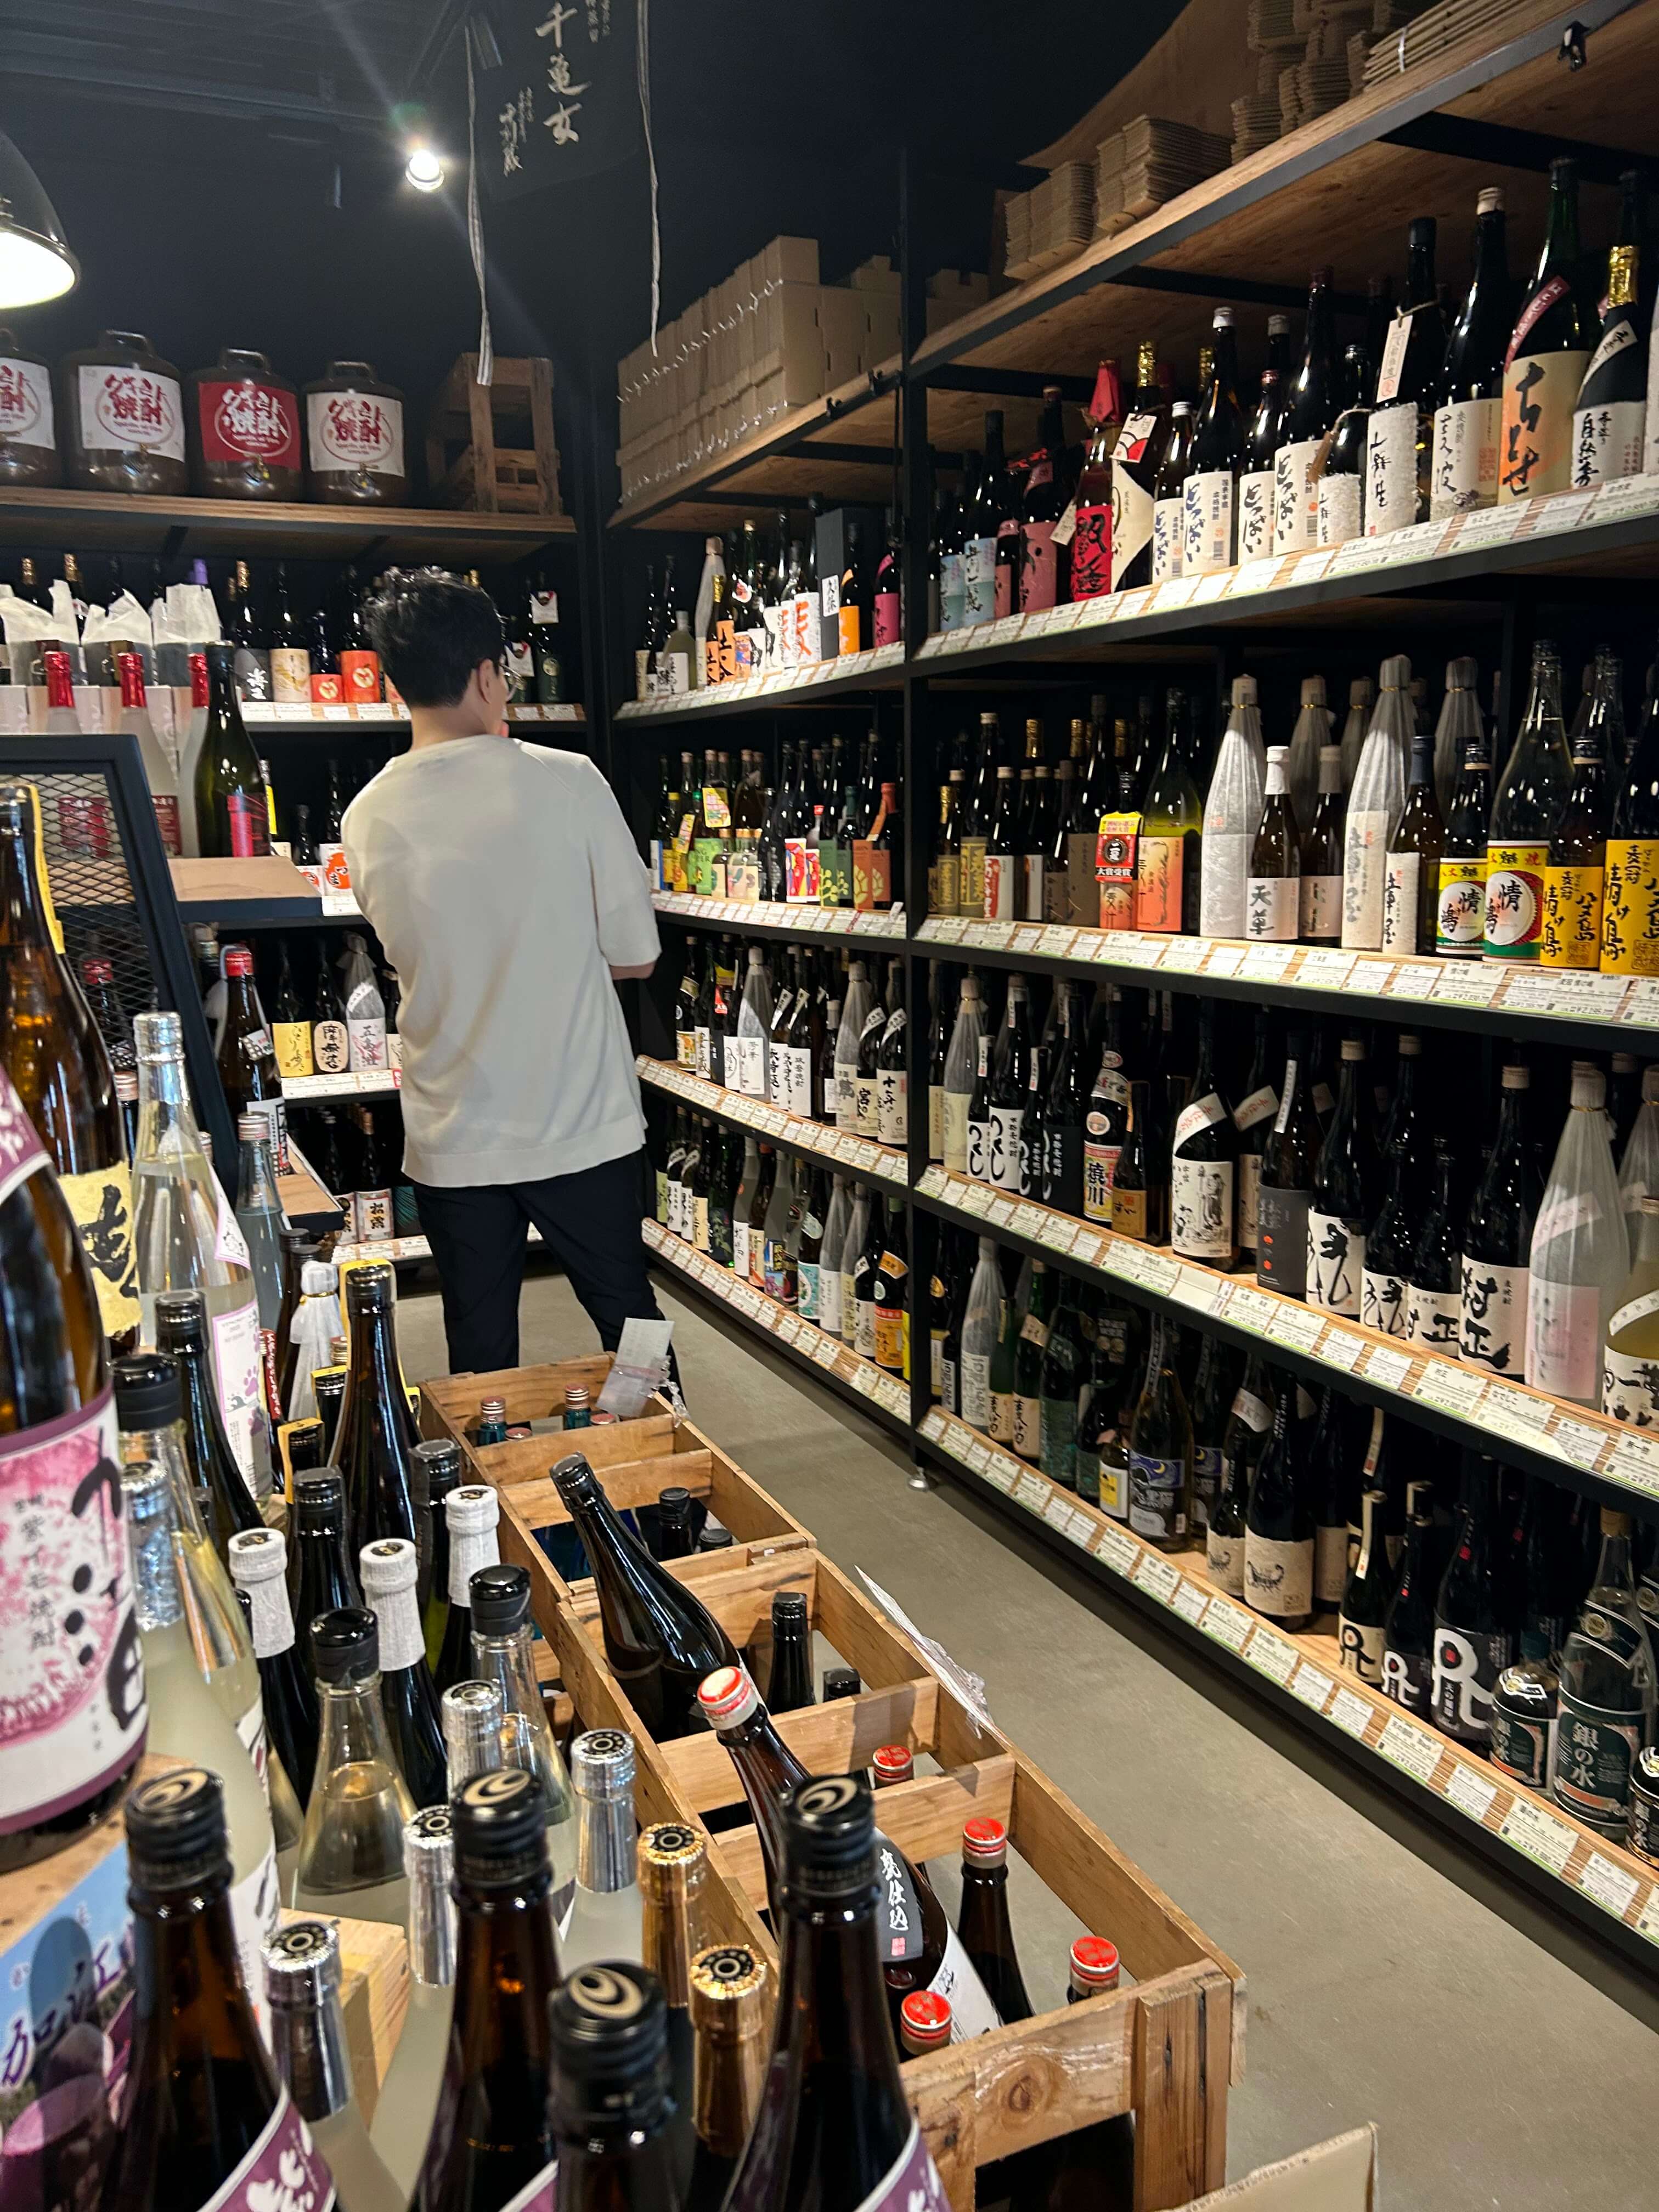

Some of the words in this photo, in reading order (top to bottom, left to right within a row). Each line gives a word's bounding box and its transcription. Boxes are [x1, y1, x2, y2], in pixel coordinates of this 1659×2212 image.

[1249, 884, 1275, 935] 天草
[1571, 1721, 1599, 1789] 銀の水
[880, 1847, 909, 1931] 甕仕込
